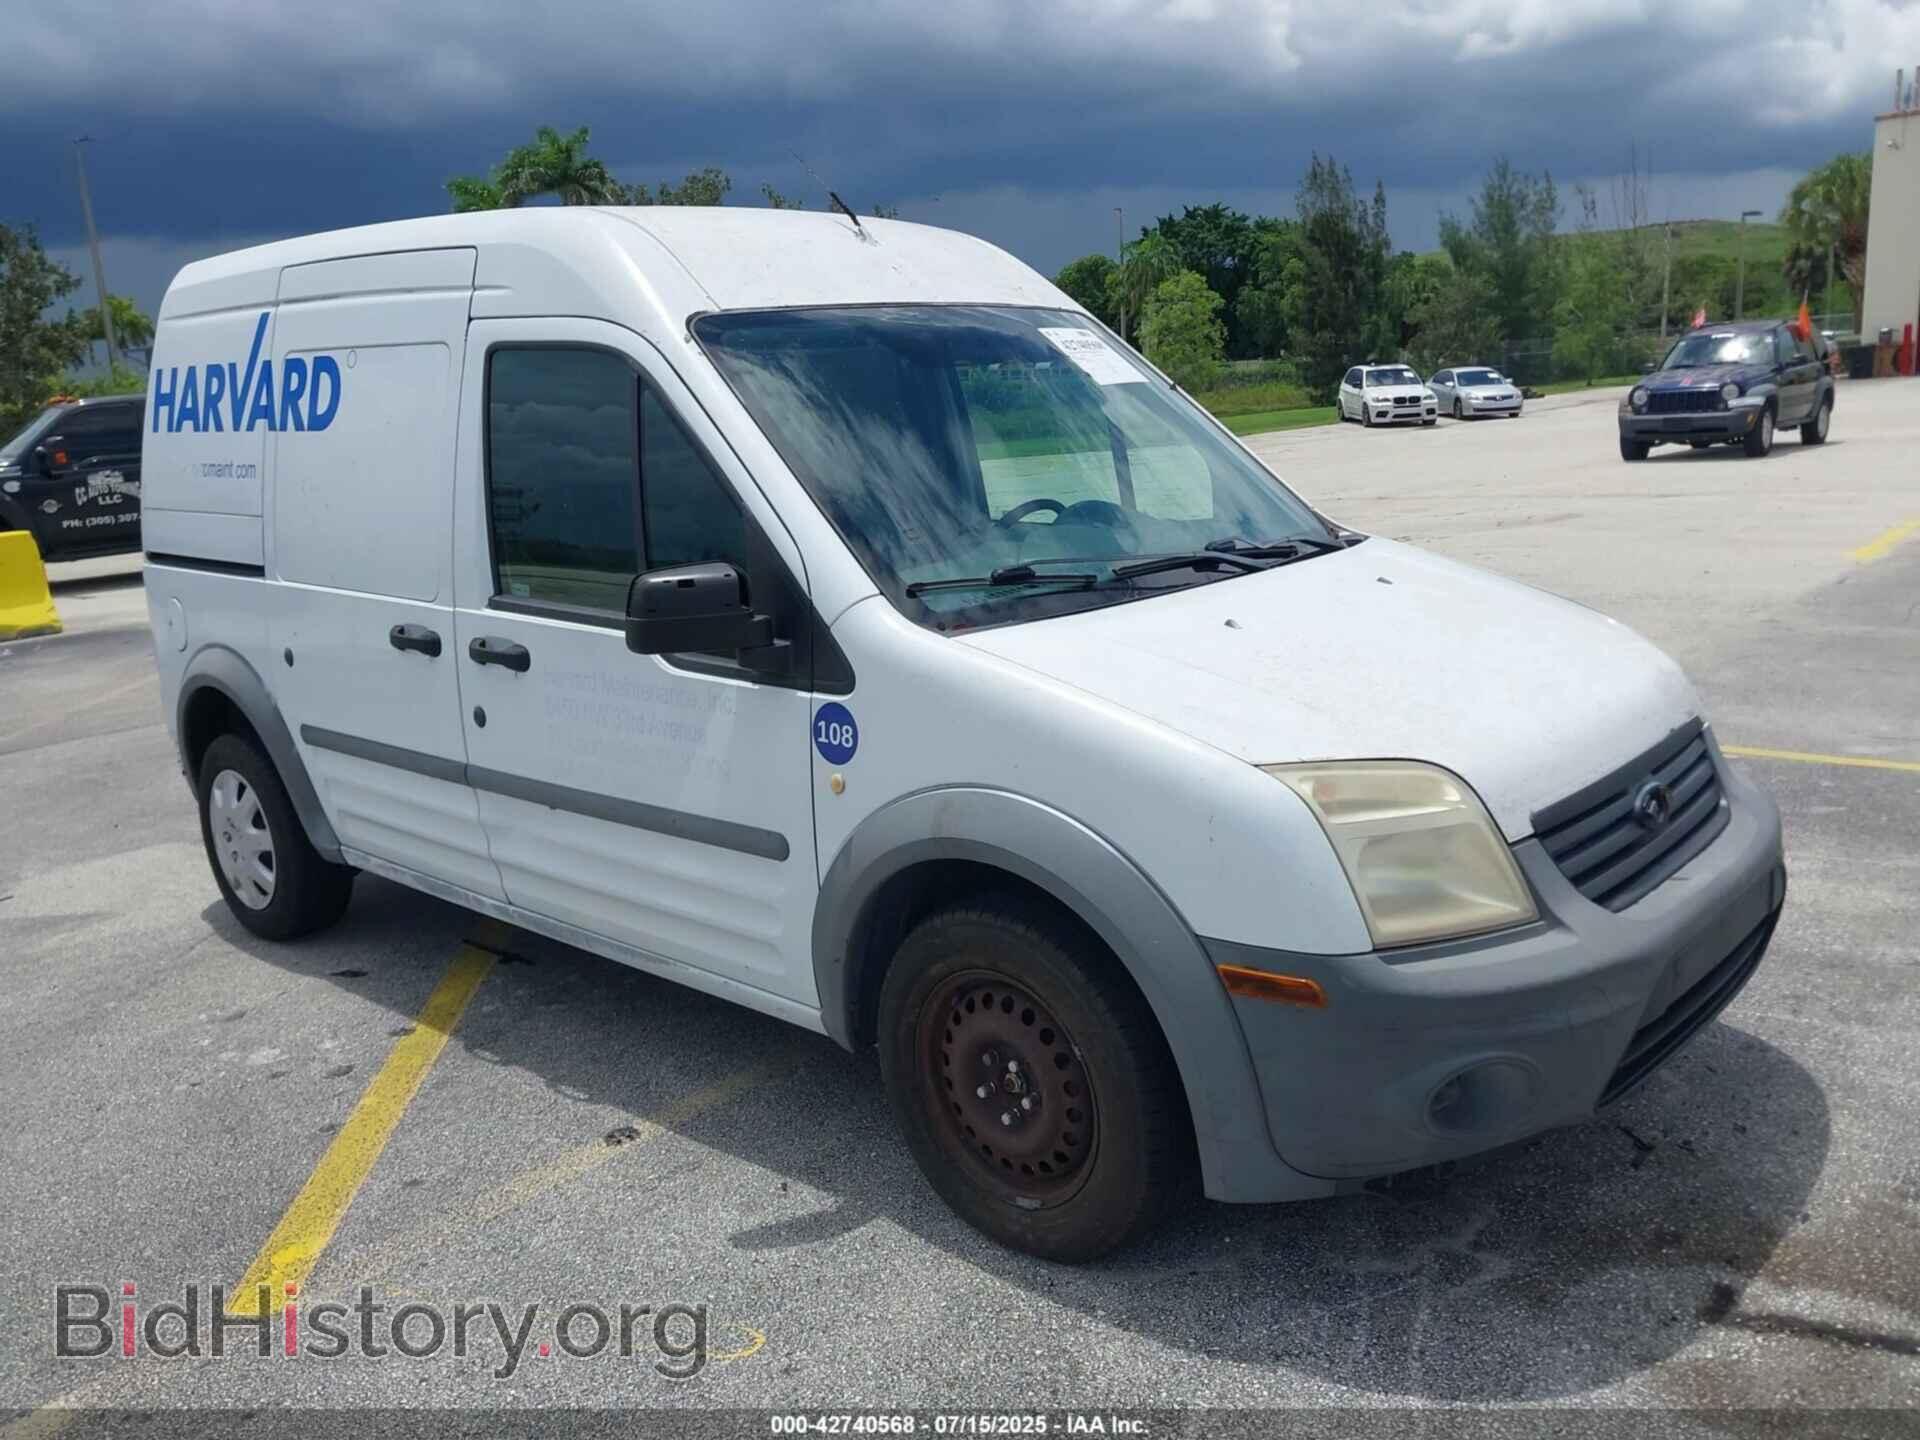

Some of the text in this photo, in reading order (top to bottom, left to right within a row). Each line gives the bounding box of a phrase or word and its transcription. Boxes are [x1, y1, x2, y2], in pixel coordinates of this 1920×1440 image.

[152, 311, 341, 433] HARVARD
[98, 494, 123, 505] LLC
[86, 514, 116, 527] (305)
[817, 720, 854, 748] 108
